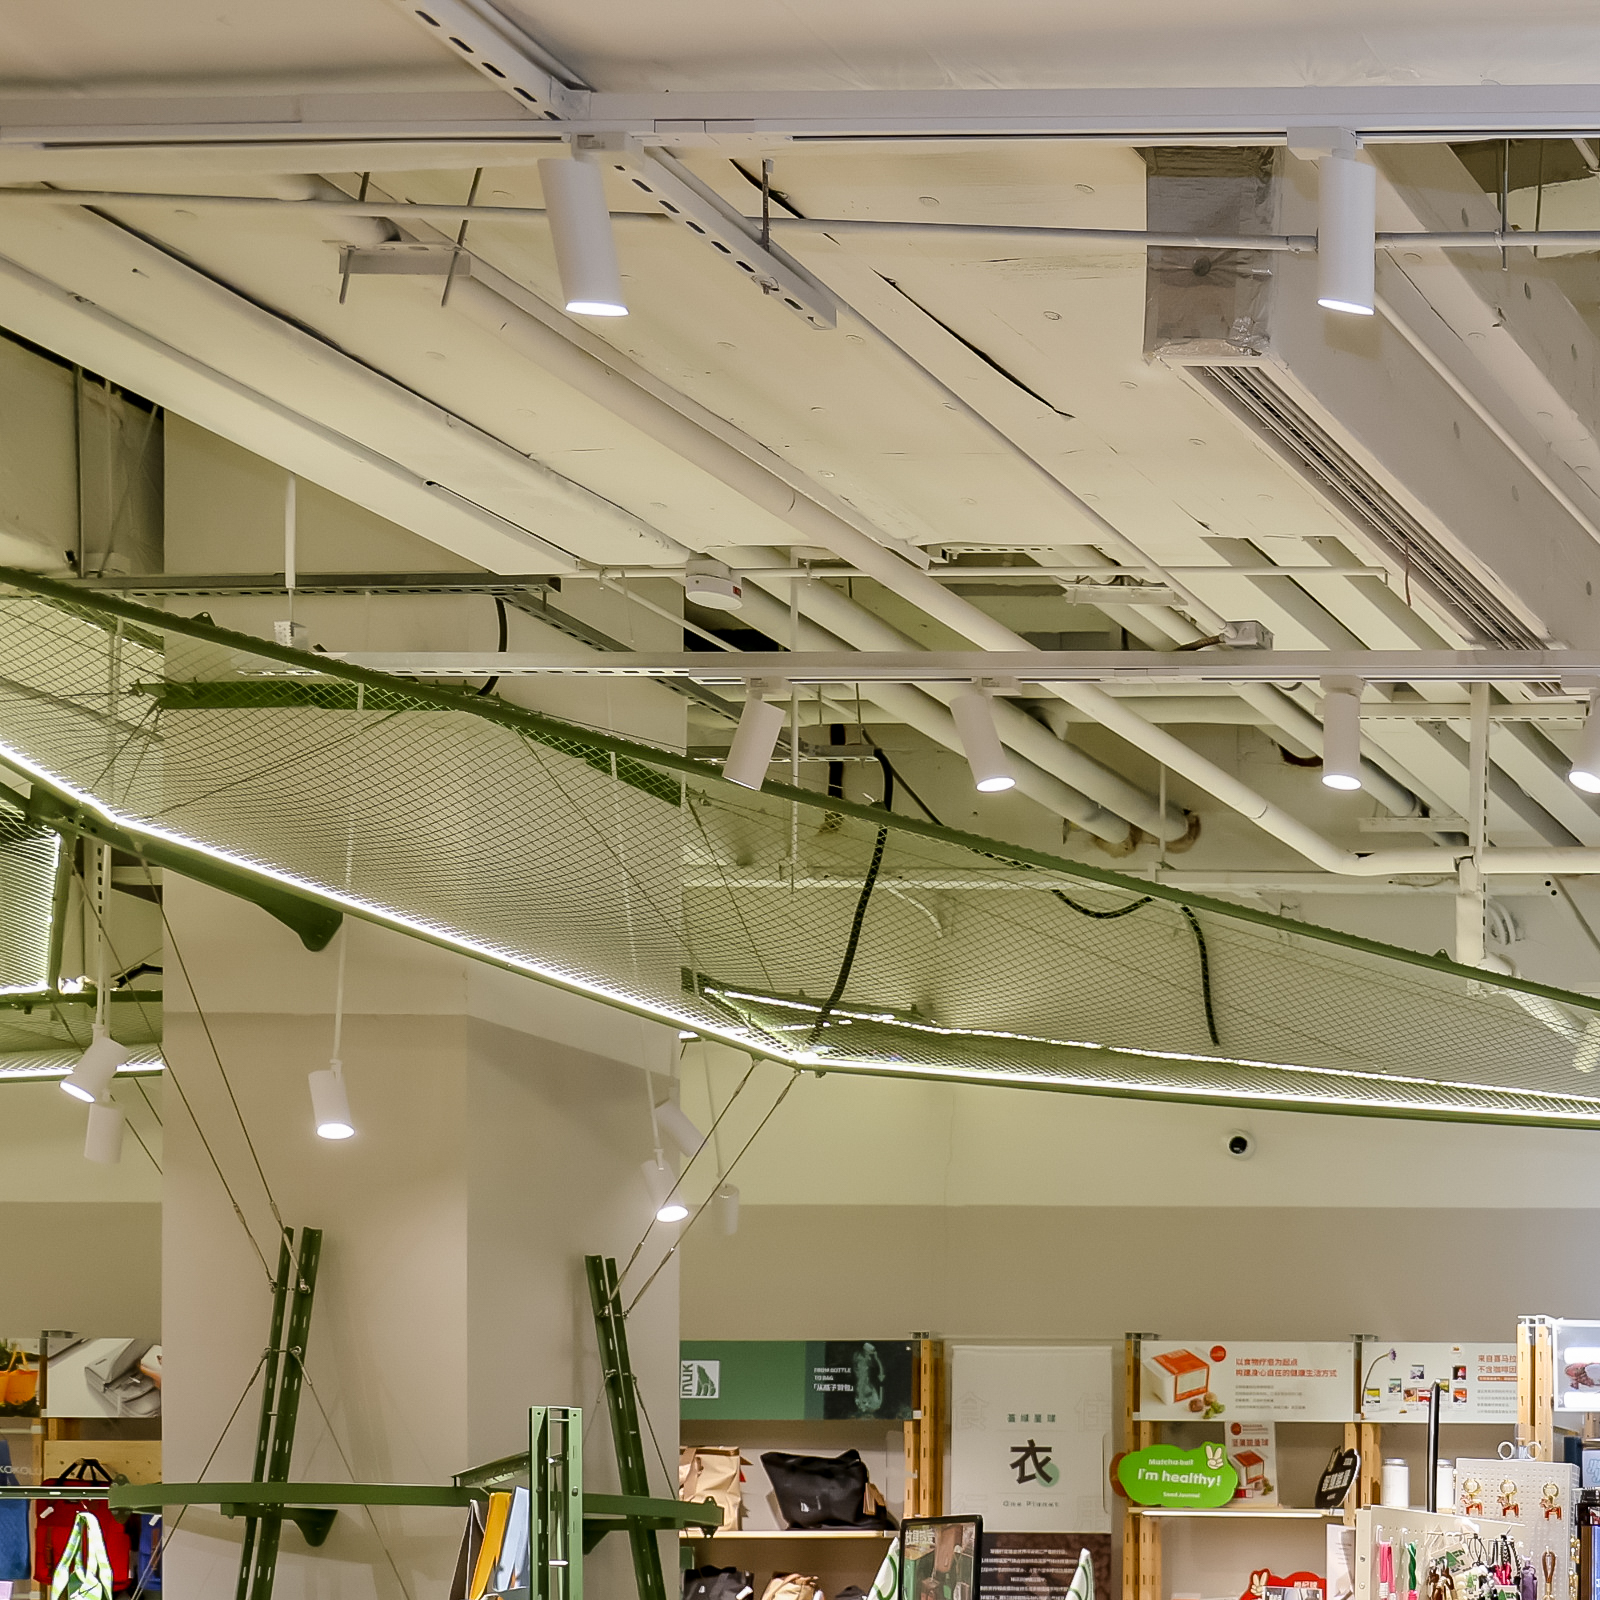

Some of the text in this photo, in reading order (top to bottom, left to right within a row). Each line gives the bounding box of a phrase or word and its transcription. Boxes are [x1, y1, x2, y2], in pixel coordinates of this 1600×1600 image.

[1009, 1439, 1053, 1485] 衣
[1138, 1468, 1222, 1488] I'm healthy!
